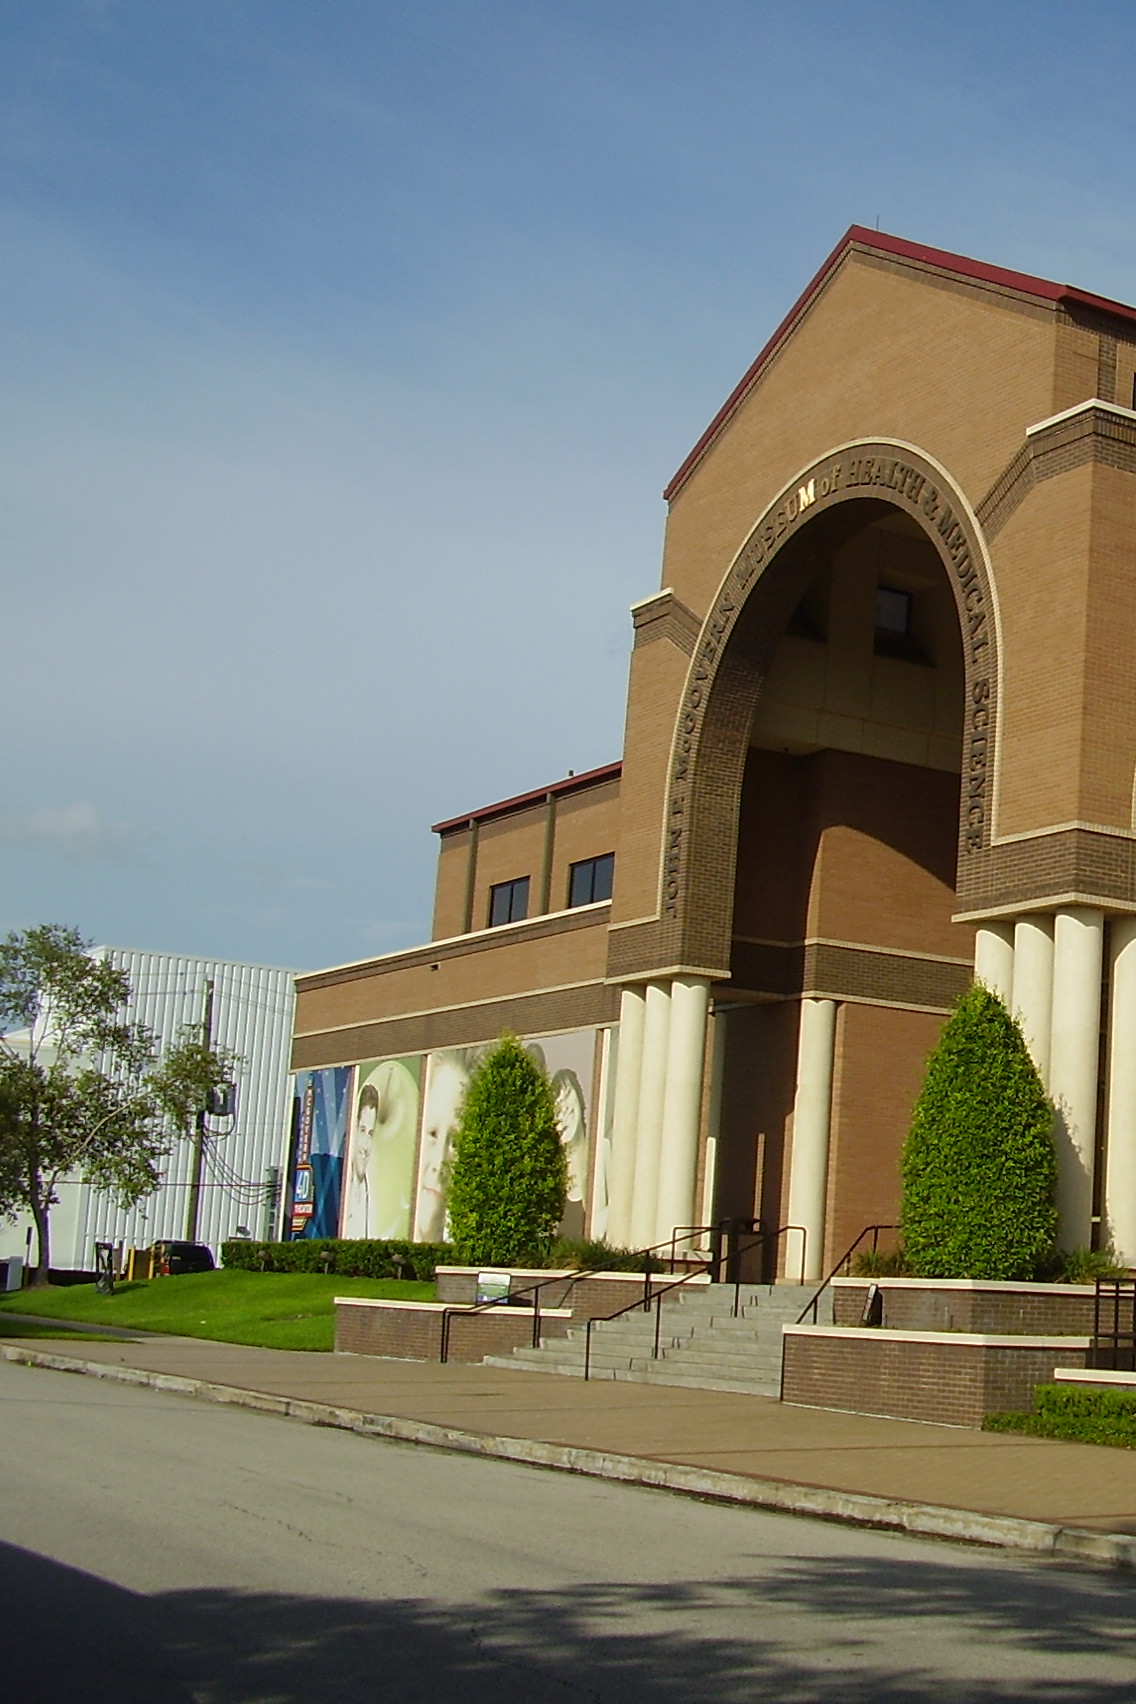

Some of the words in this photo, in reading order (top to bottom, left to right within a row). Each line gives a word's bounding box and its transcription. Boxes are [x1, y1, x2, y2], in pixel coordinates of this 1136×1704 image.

[664, 826, 683, 919] JOHN
[734, 478, 816, 590] MUSEUM
[845, 458, 927, 505] HEALTH
[922, 489, 940, 521] &
[936, 504, 991, 664] MEDICAL
[965, 678, 991, 854] SCIENCE
